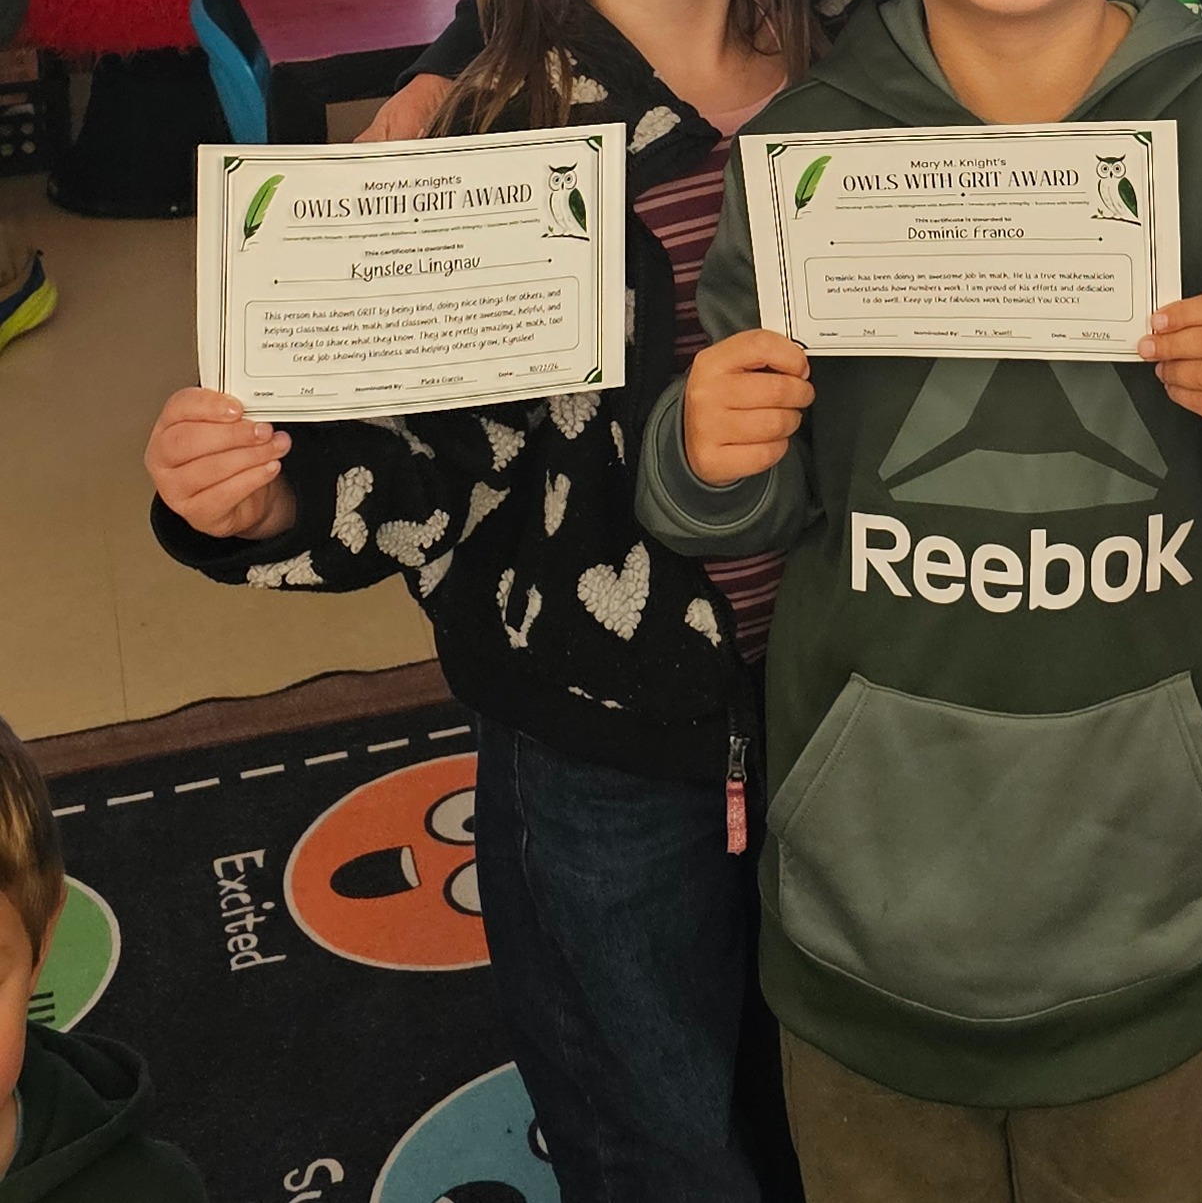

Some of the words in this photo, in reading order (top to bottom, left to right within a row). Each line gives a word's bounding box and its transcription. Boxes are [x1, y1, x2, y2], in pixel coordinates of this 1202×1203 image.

[910, 160, 940, 170] Mary
[944, 160, 956, 168] M.
[960, 158, 1007, 169] Knight's
[365, 181, 395, 192] Mary
[398, 179, 411, 189] M.
[415, 175, 462, 188] Knight's
[843, 173, 899, 191] OWLS
[904, 172, 952, 190] WITH
[959, 171, 1002, 188] GRIT
[1008, 169, 1079, 187] AWARD
[293, 198, 351, 219] OWLS
[357, 195, 406, 216] WITH
[413, 191, 456, 212] GRIT
[462, 184, 532, 208] AWARD
[908, 226, 968, 240] Dominic
[974, 225, 1025, 239] Franco
[351, 261, 413, 282] Kynslee
[419, 257, 481, 277] Lingnau
[265, 312, 281, 321] This
[283, 312, 310, 321] person
[312, 311, 326, 319] has
[329, 309, 355, 318] shown
[357, 307, 377, 316] GRIT
[379, 307, 390, 317] by
[392, 304, 414, 315] being
[437, 300, 459, 311] doing
[461, 298, 477, 307] nice
[479, 295, 503, 306] things
[506, 294, 517, 302] for
[548, 289, 562, 297] and
[851, 511, 1194, 614] Reebok
[213, 848, 288, 972] Excited
